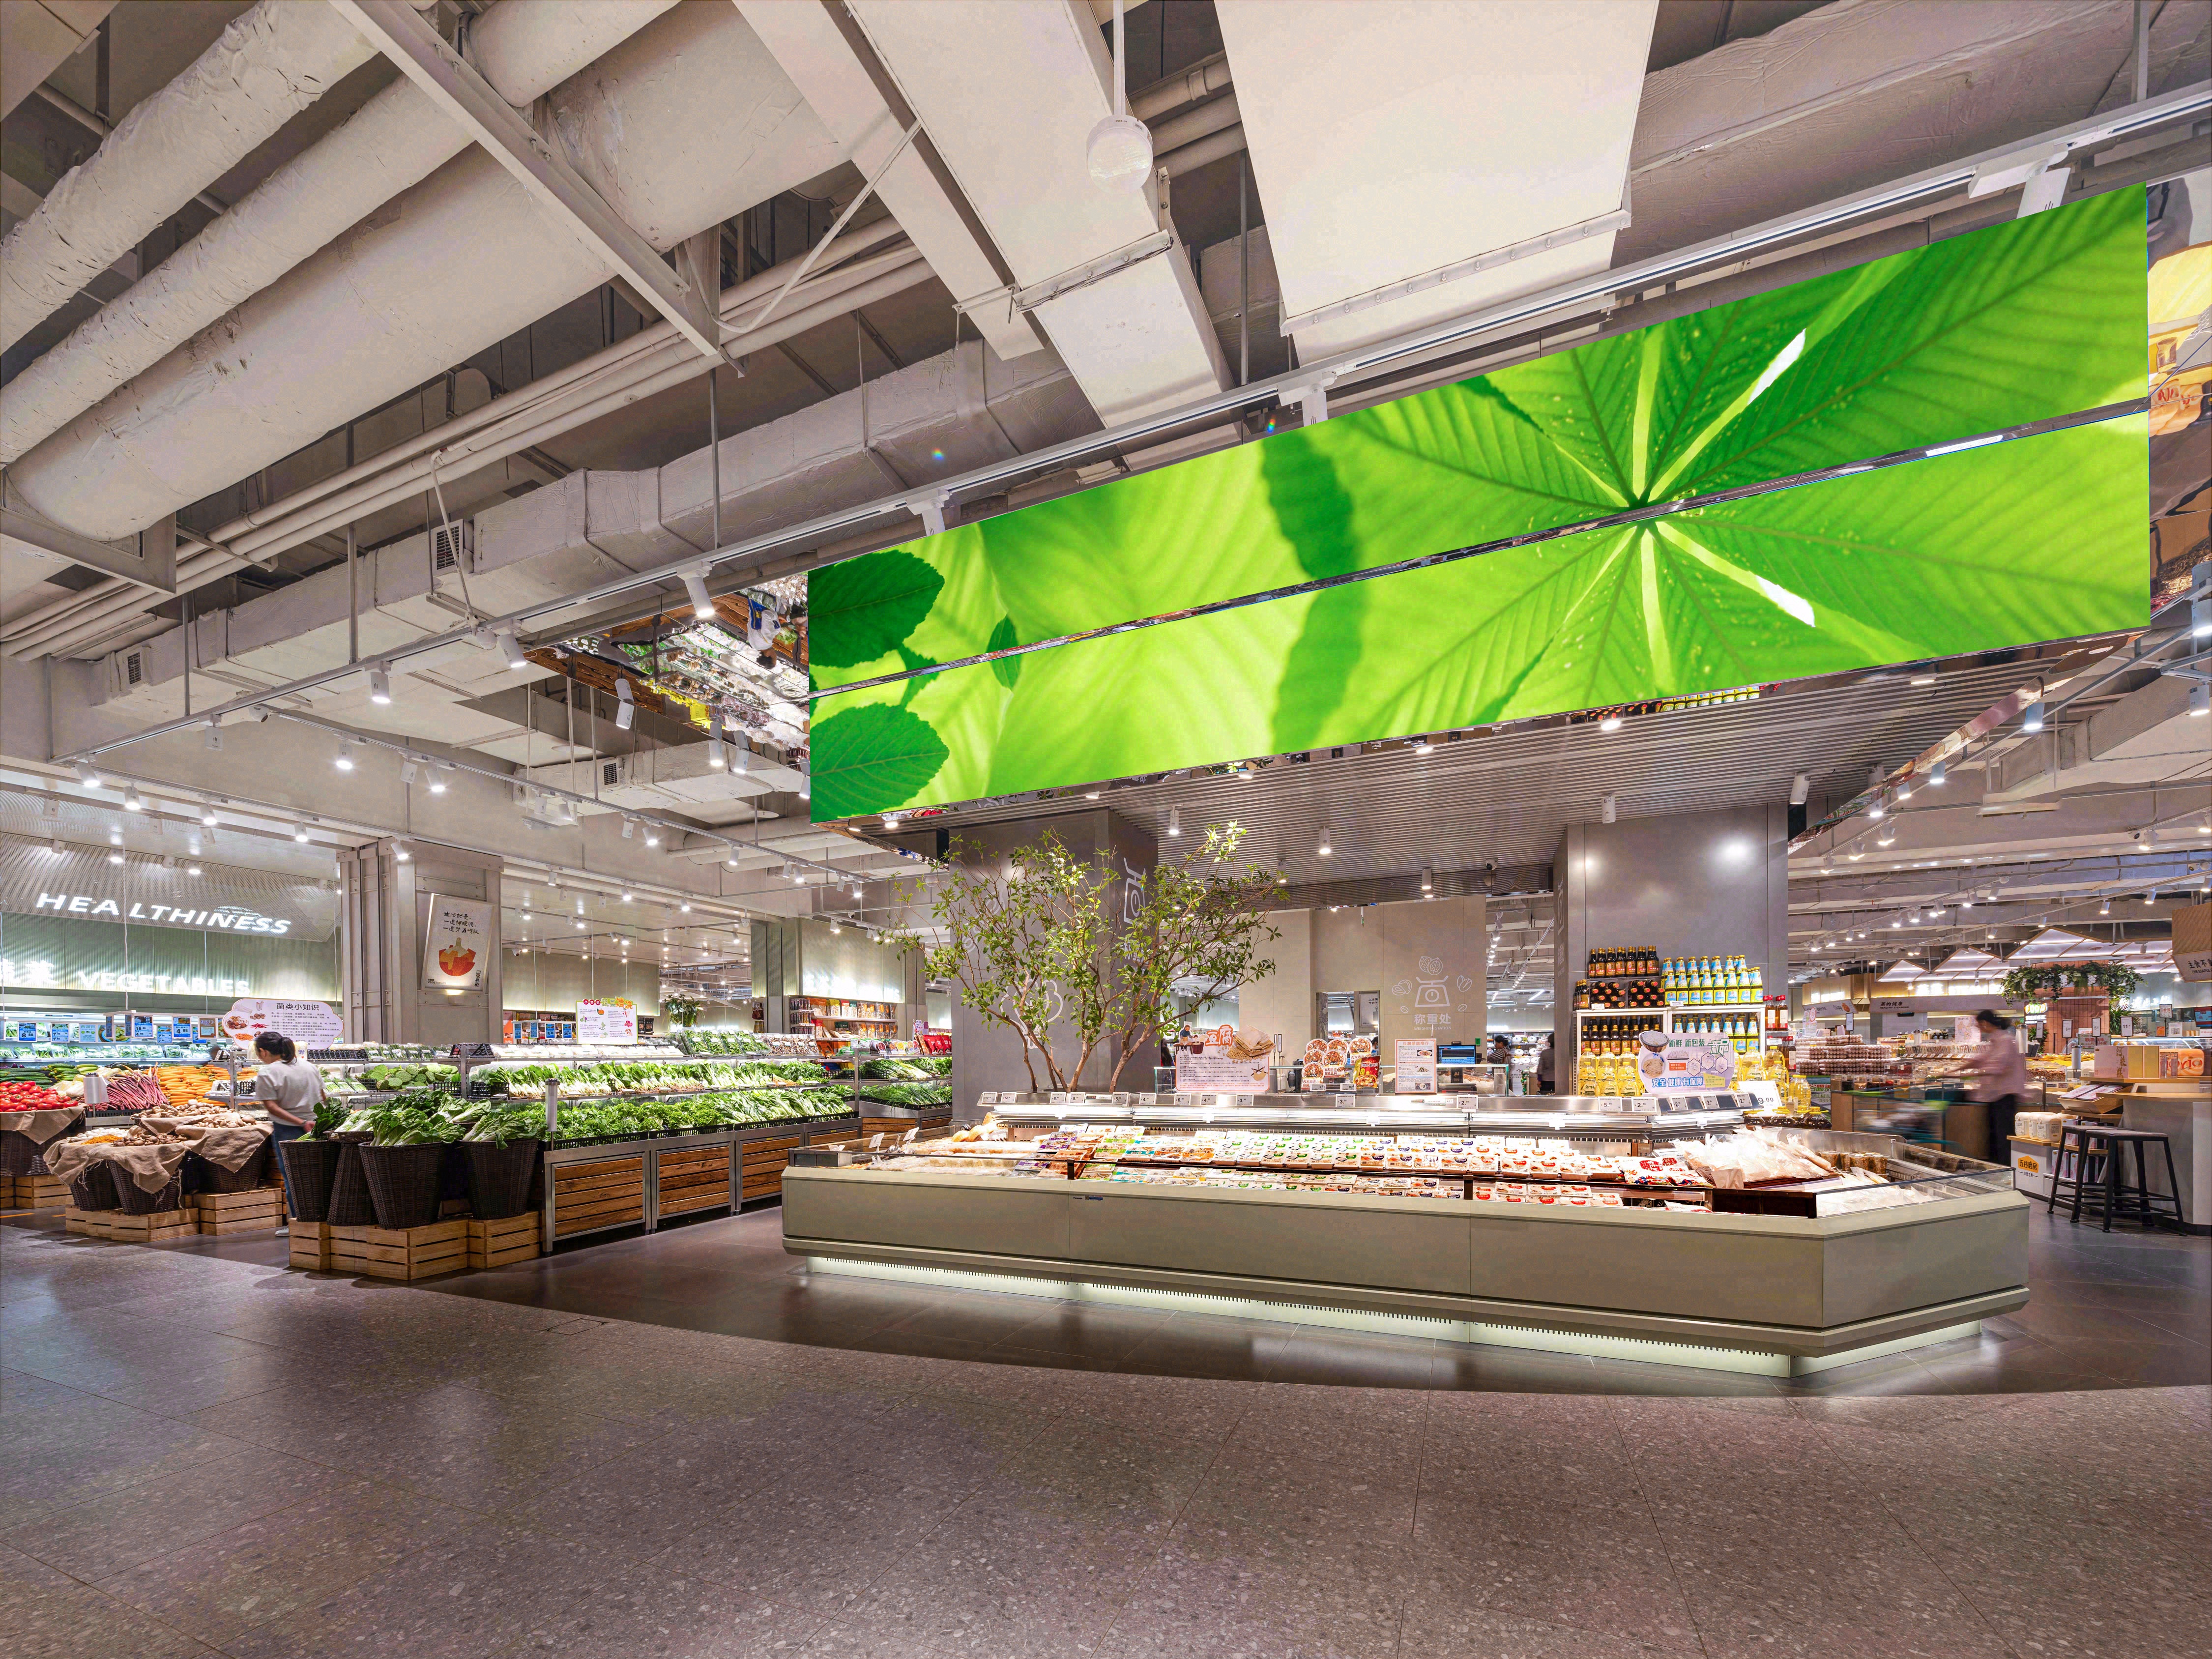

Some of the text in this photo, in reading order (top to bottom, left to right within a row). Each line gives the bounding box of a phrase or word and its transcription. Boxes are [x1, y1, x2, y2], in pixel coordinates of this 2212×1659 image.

[78, 971, 250, 995] VEGETABLES
[1414, 1013, 1451, 1024] 称重处
[1206, 1025, 1232, 1046] 豆腐
[1669, 1039, 1705, 1048] 新鲜 新包装
[1652, 1078, 1666, 1087] 安全
[1668, 1078, 1681, 1086] 健康
[1683, 1077, 1703, 1086] 有保障
[2019, 1159, 2037, 1171] 五谷磨房
